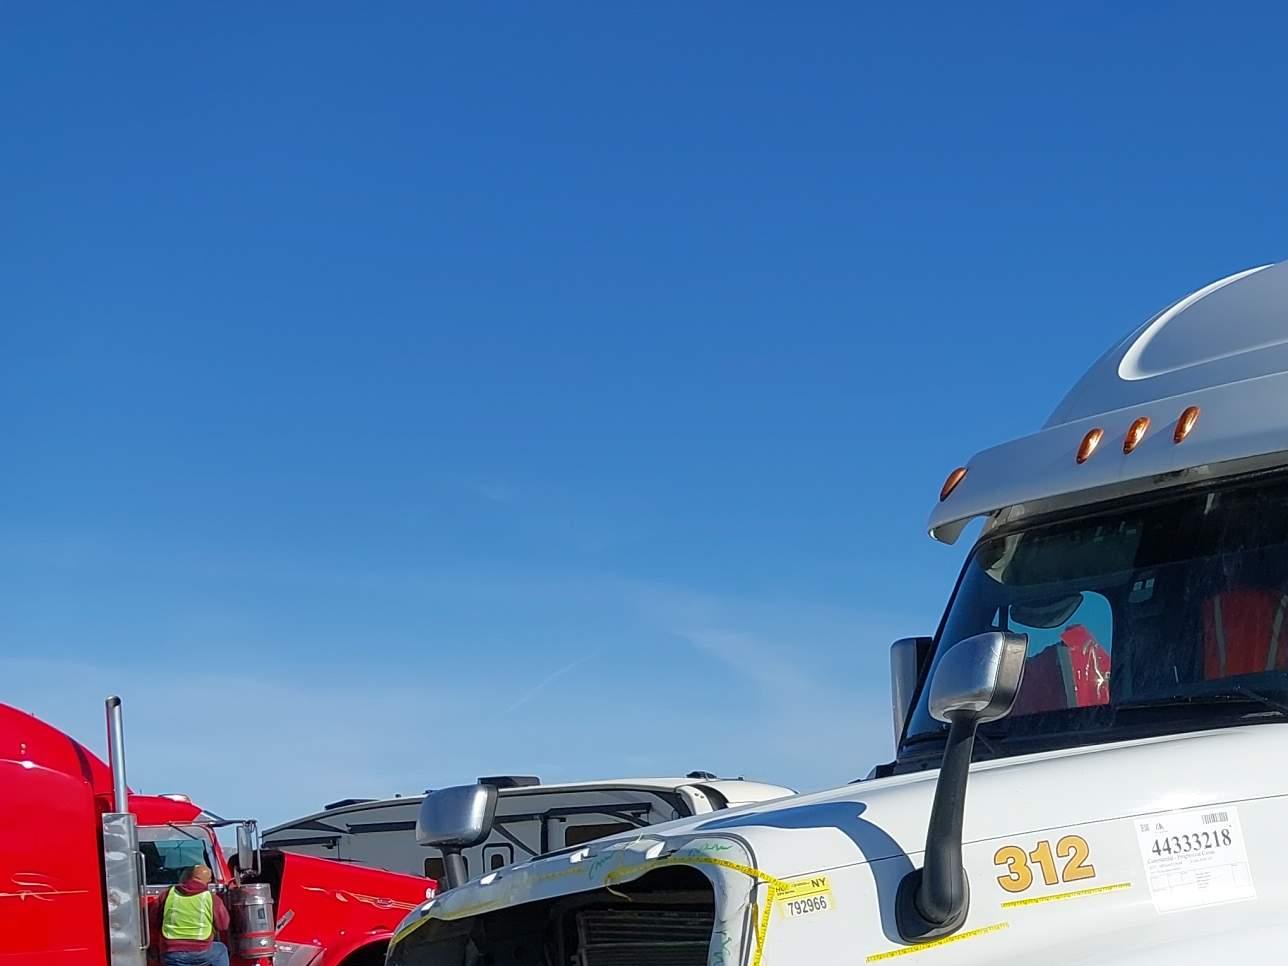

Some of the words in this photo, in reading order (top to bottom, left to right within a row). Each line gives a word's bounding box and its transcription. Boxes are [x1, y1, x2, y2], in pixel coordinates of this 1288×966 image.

[1151, 828, 1232, 856] 44333218
[994, 834, 1096, 893] 312
[810, 877, 826, 888] NY
[787, 895, 828, 916] 792966
